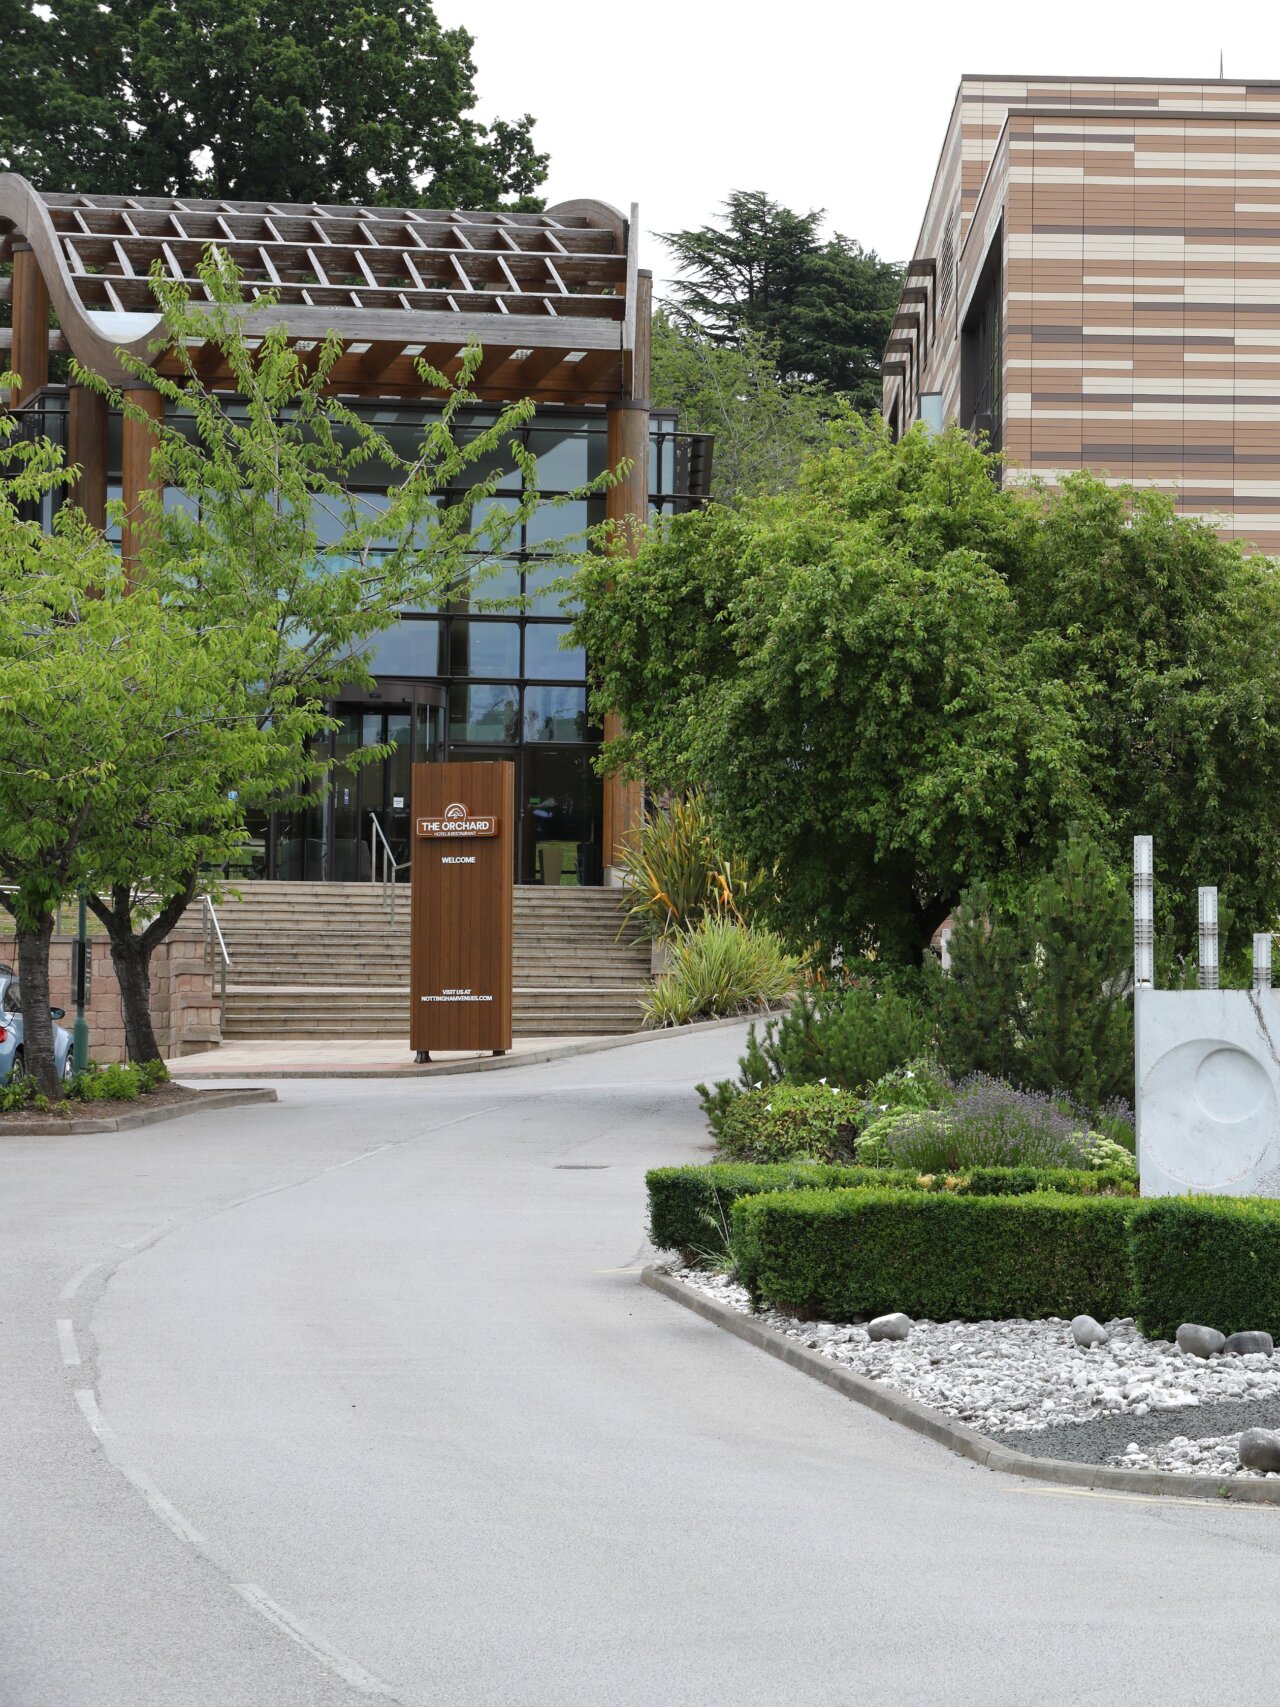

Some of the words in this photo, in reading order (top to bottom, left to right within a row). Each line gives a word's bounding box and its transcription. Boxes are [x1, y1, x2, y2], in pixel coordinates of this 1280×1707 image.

[422, 822, 440, 832] THE
[442, 822, 489, 830] ORCHARD
[441, 856, 476, 864] WELCOME
